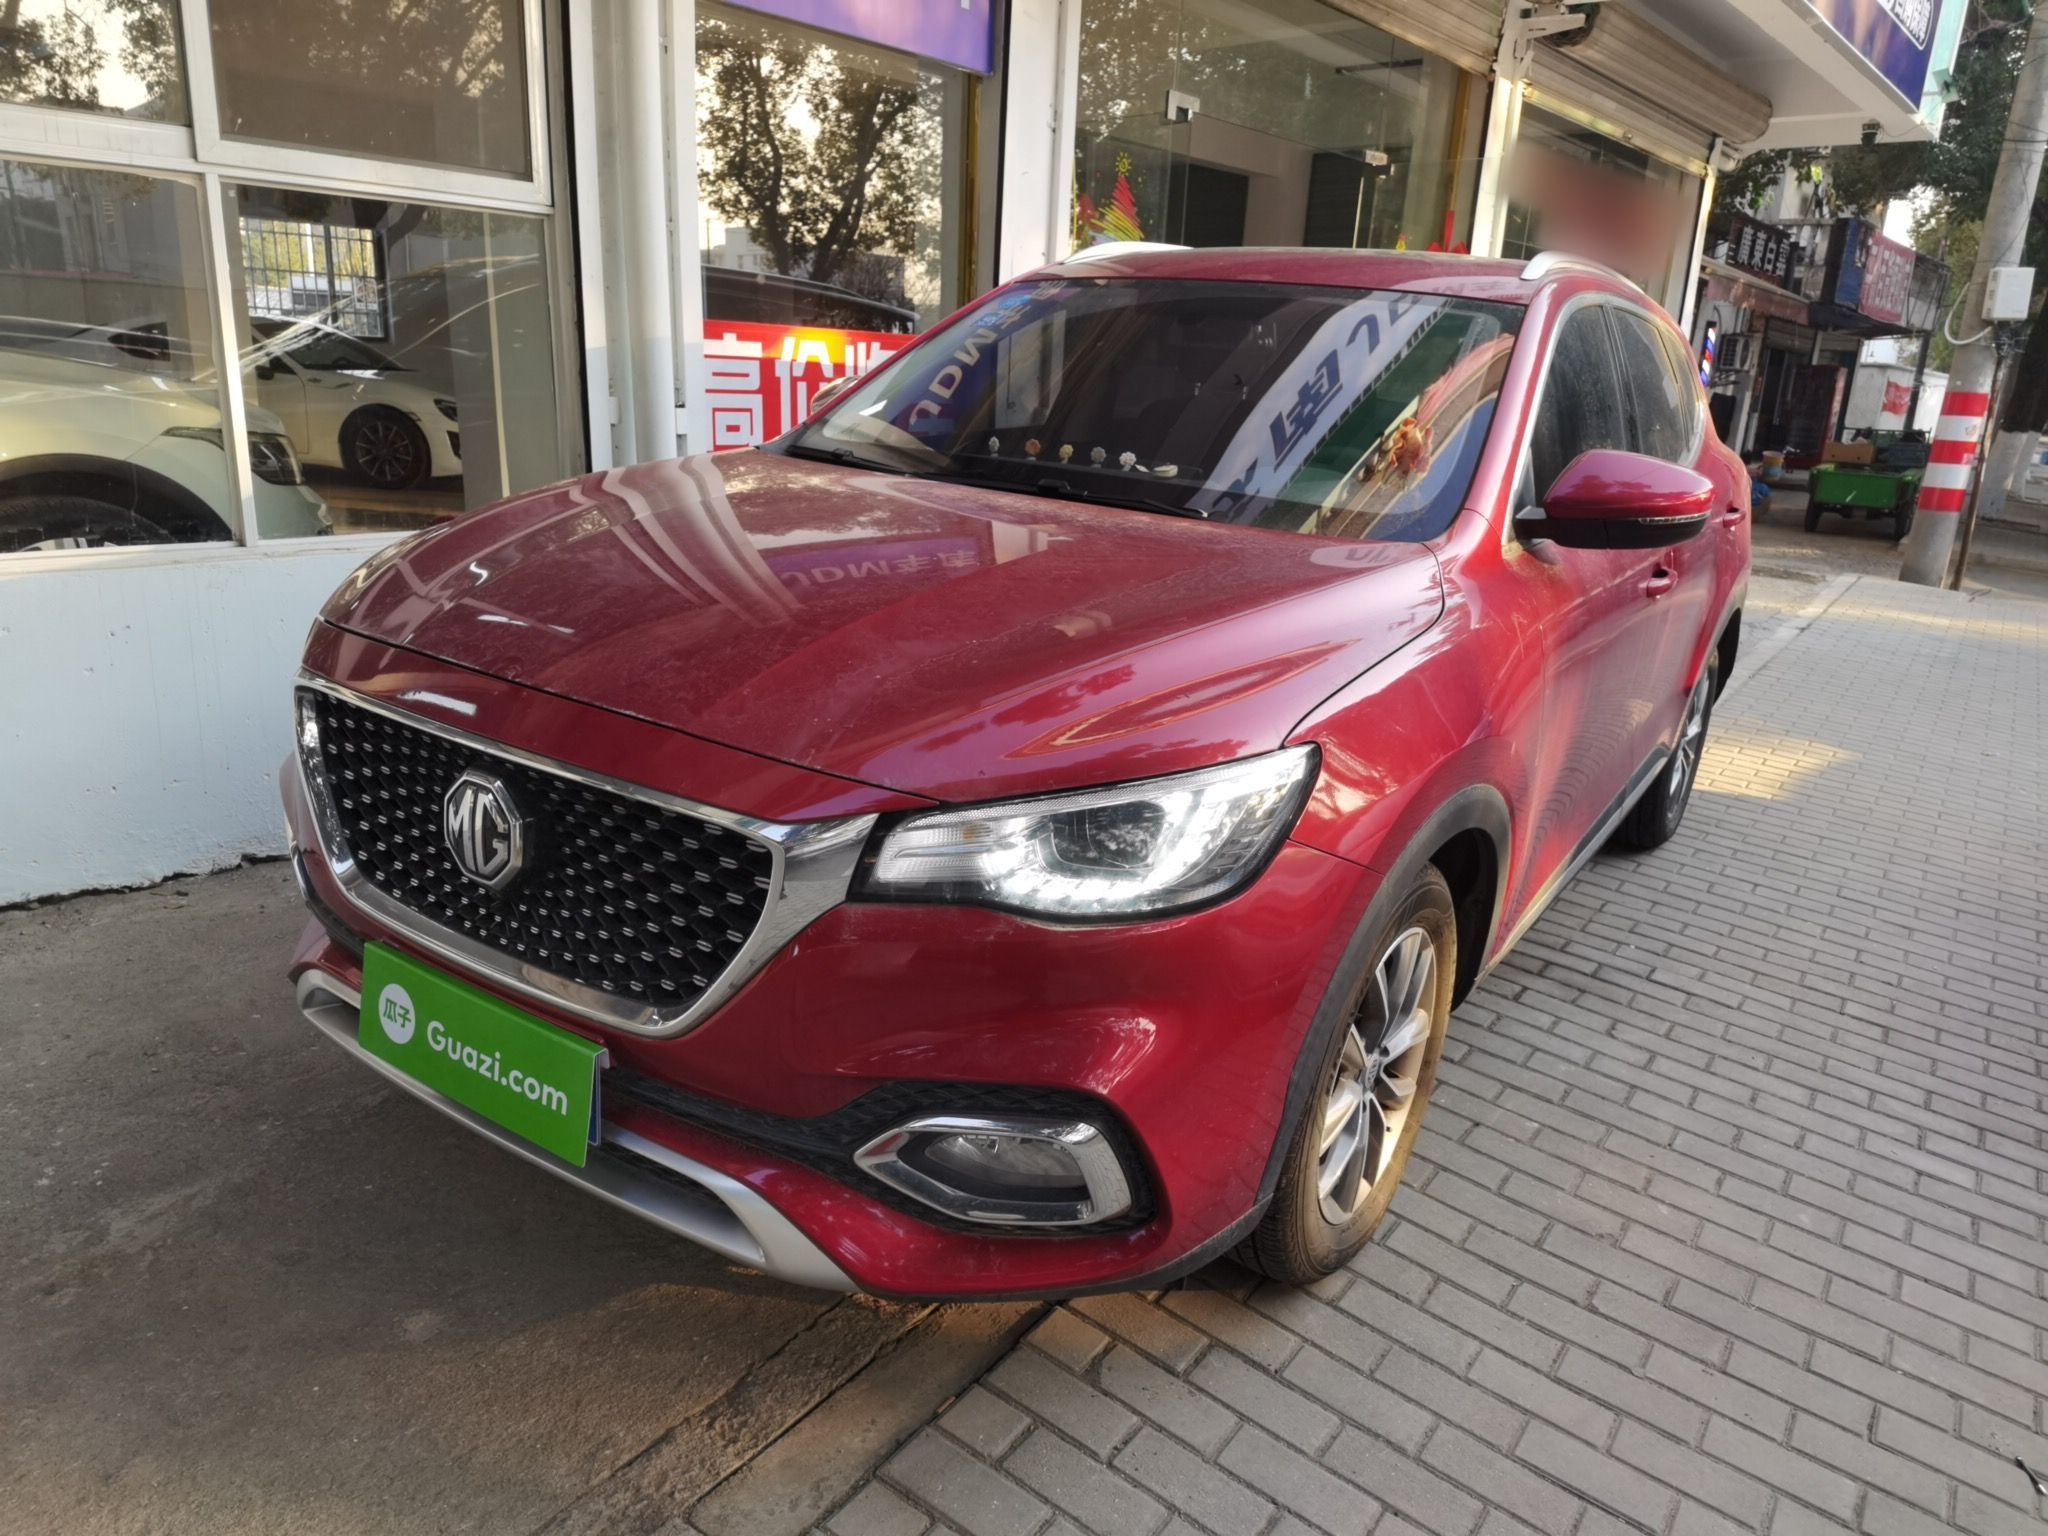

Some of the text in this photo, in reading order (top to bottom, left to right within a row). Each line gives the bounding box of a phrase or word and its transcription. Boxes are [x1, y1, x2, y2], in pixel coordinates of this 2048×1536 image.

[447, 786, 510, 876] MG
[382, 998, 412, 1028] 瓜子
[426, 1022, 568, 1115] Guazi.com
